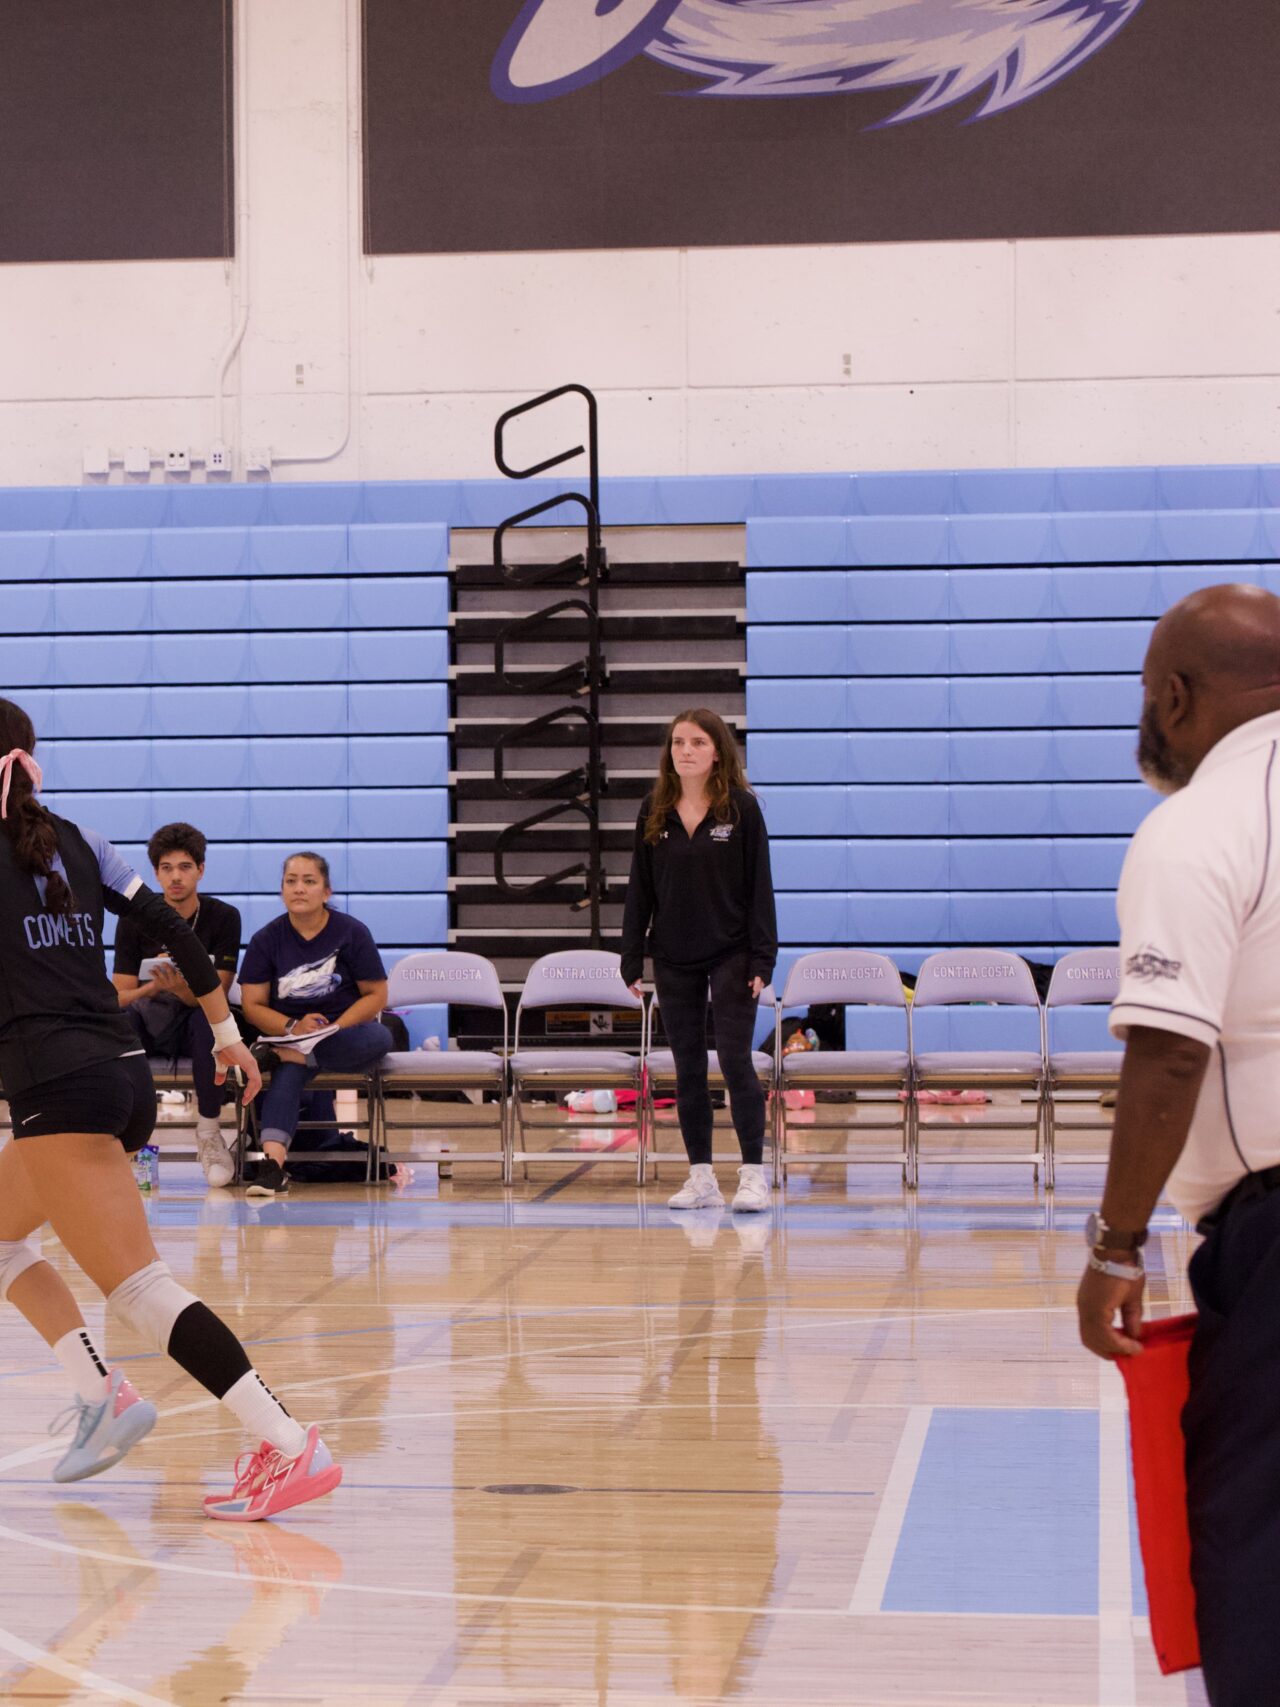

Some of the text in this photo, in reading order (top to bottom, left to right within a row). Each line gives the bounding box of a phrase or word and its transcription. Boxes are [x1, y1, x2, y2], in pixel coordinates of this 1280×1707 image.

[23, 912, 95, 950] COMETS
[401, 968, 482, 981] CONTRA COSTA
[542, 967, 621, 979] CONTRA COSTA
[803, 967, 884, 980] CONTRA COSTA
[933, 965, 1015, 979] CONTRA COSTA
[1066, 967, 1113, 979] CONTRA
